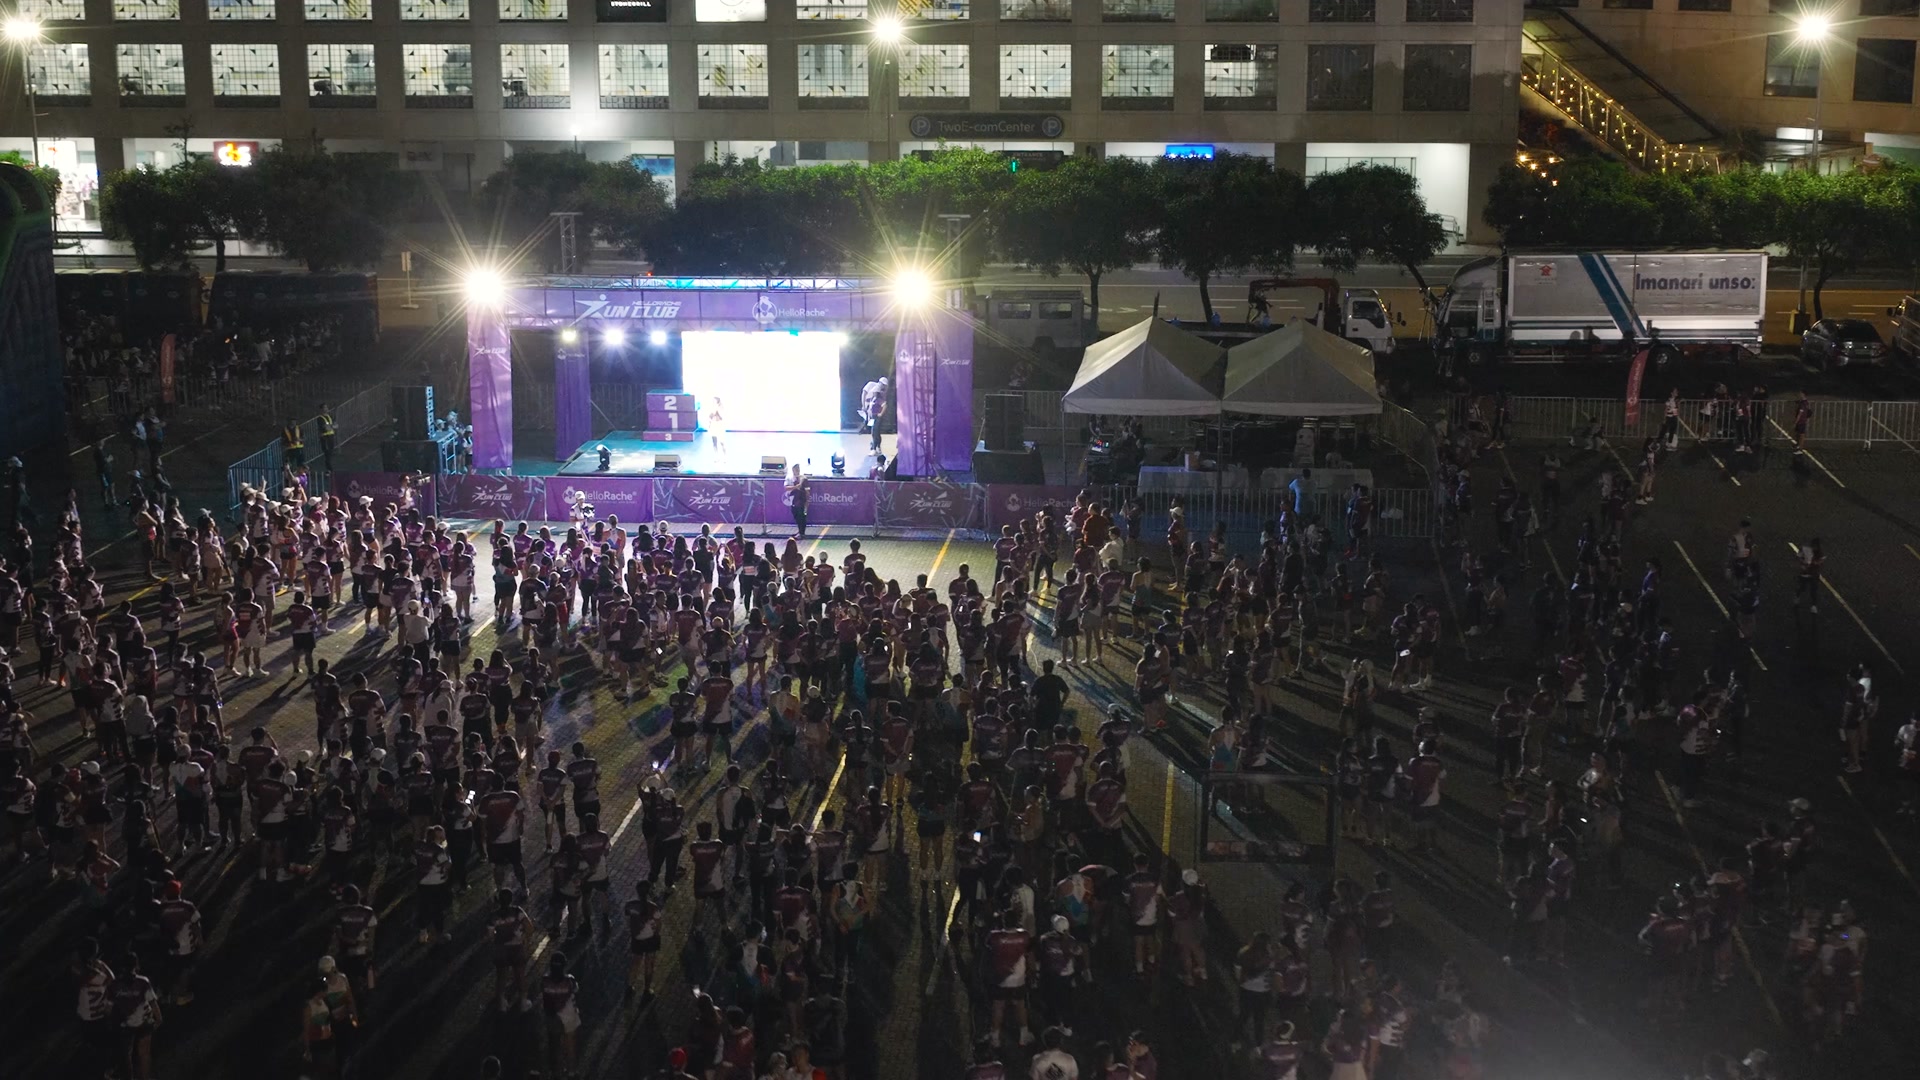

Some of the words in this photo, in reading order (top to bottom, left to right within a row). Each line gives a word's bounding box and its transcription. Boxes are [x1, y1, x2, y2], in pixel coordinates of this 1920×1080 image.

[1636, 272, 1703, 290] Imanari
[631, 306, 680, 319] CLUB
[664, 395, 677, 410] 2
[668, 412, 678, 430] 1
[665, 433, 672, 441] 3
[585, 491, 633, 500] elloRache
[808, 493, 854, 503] elloRache
[1024, 497, 1074, 508] HelloRach
